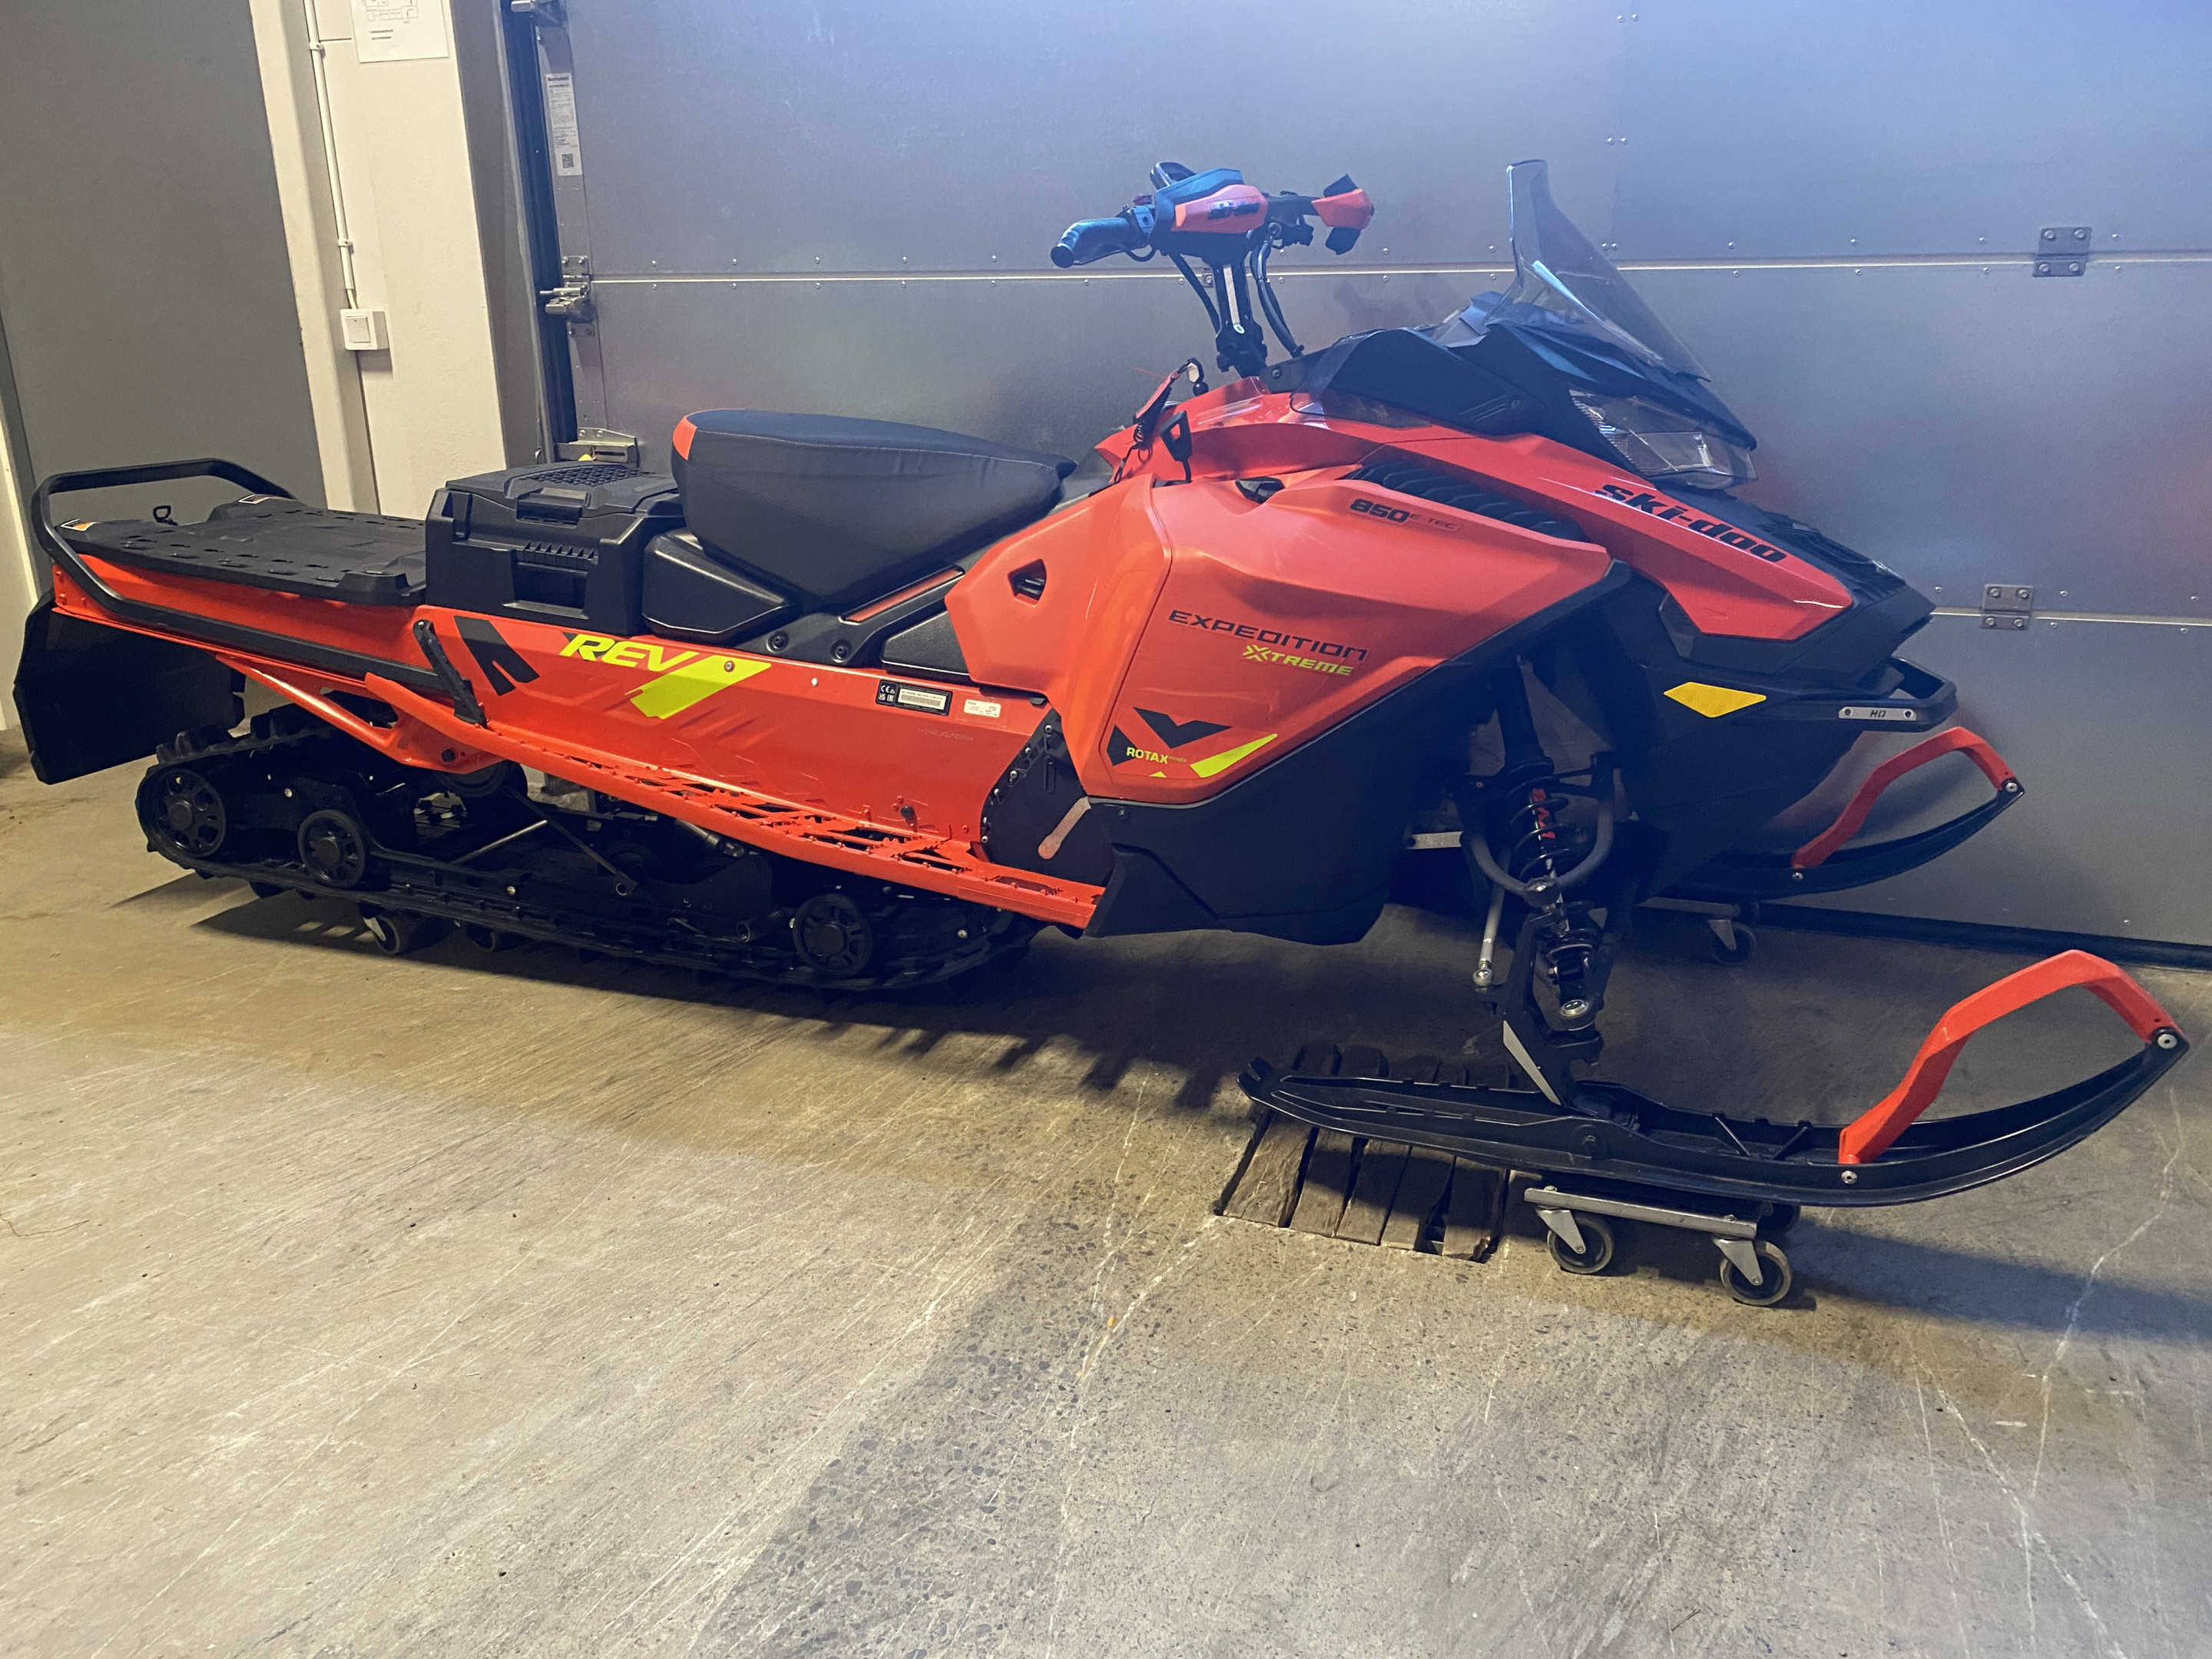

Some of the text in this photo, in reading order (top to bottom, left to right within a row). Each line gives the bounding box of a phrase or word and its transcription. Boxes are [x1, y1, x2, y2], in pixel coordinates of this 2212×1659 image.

[1349, 498, 1410, 522] 850
[1168, 609, 1369, 661] EXPEDITION
[558, 633, 700, 672] REV
[1242, 644, 1354, 676] XTREME
[1126, 747, 1169, 764] ROTAX
